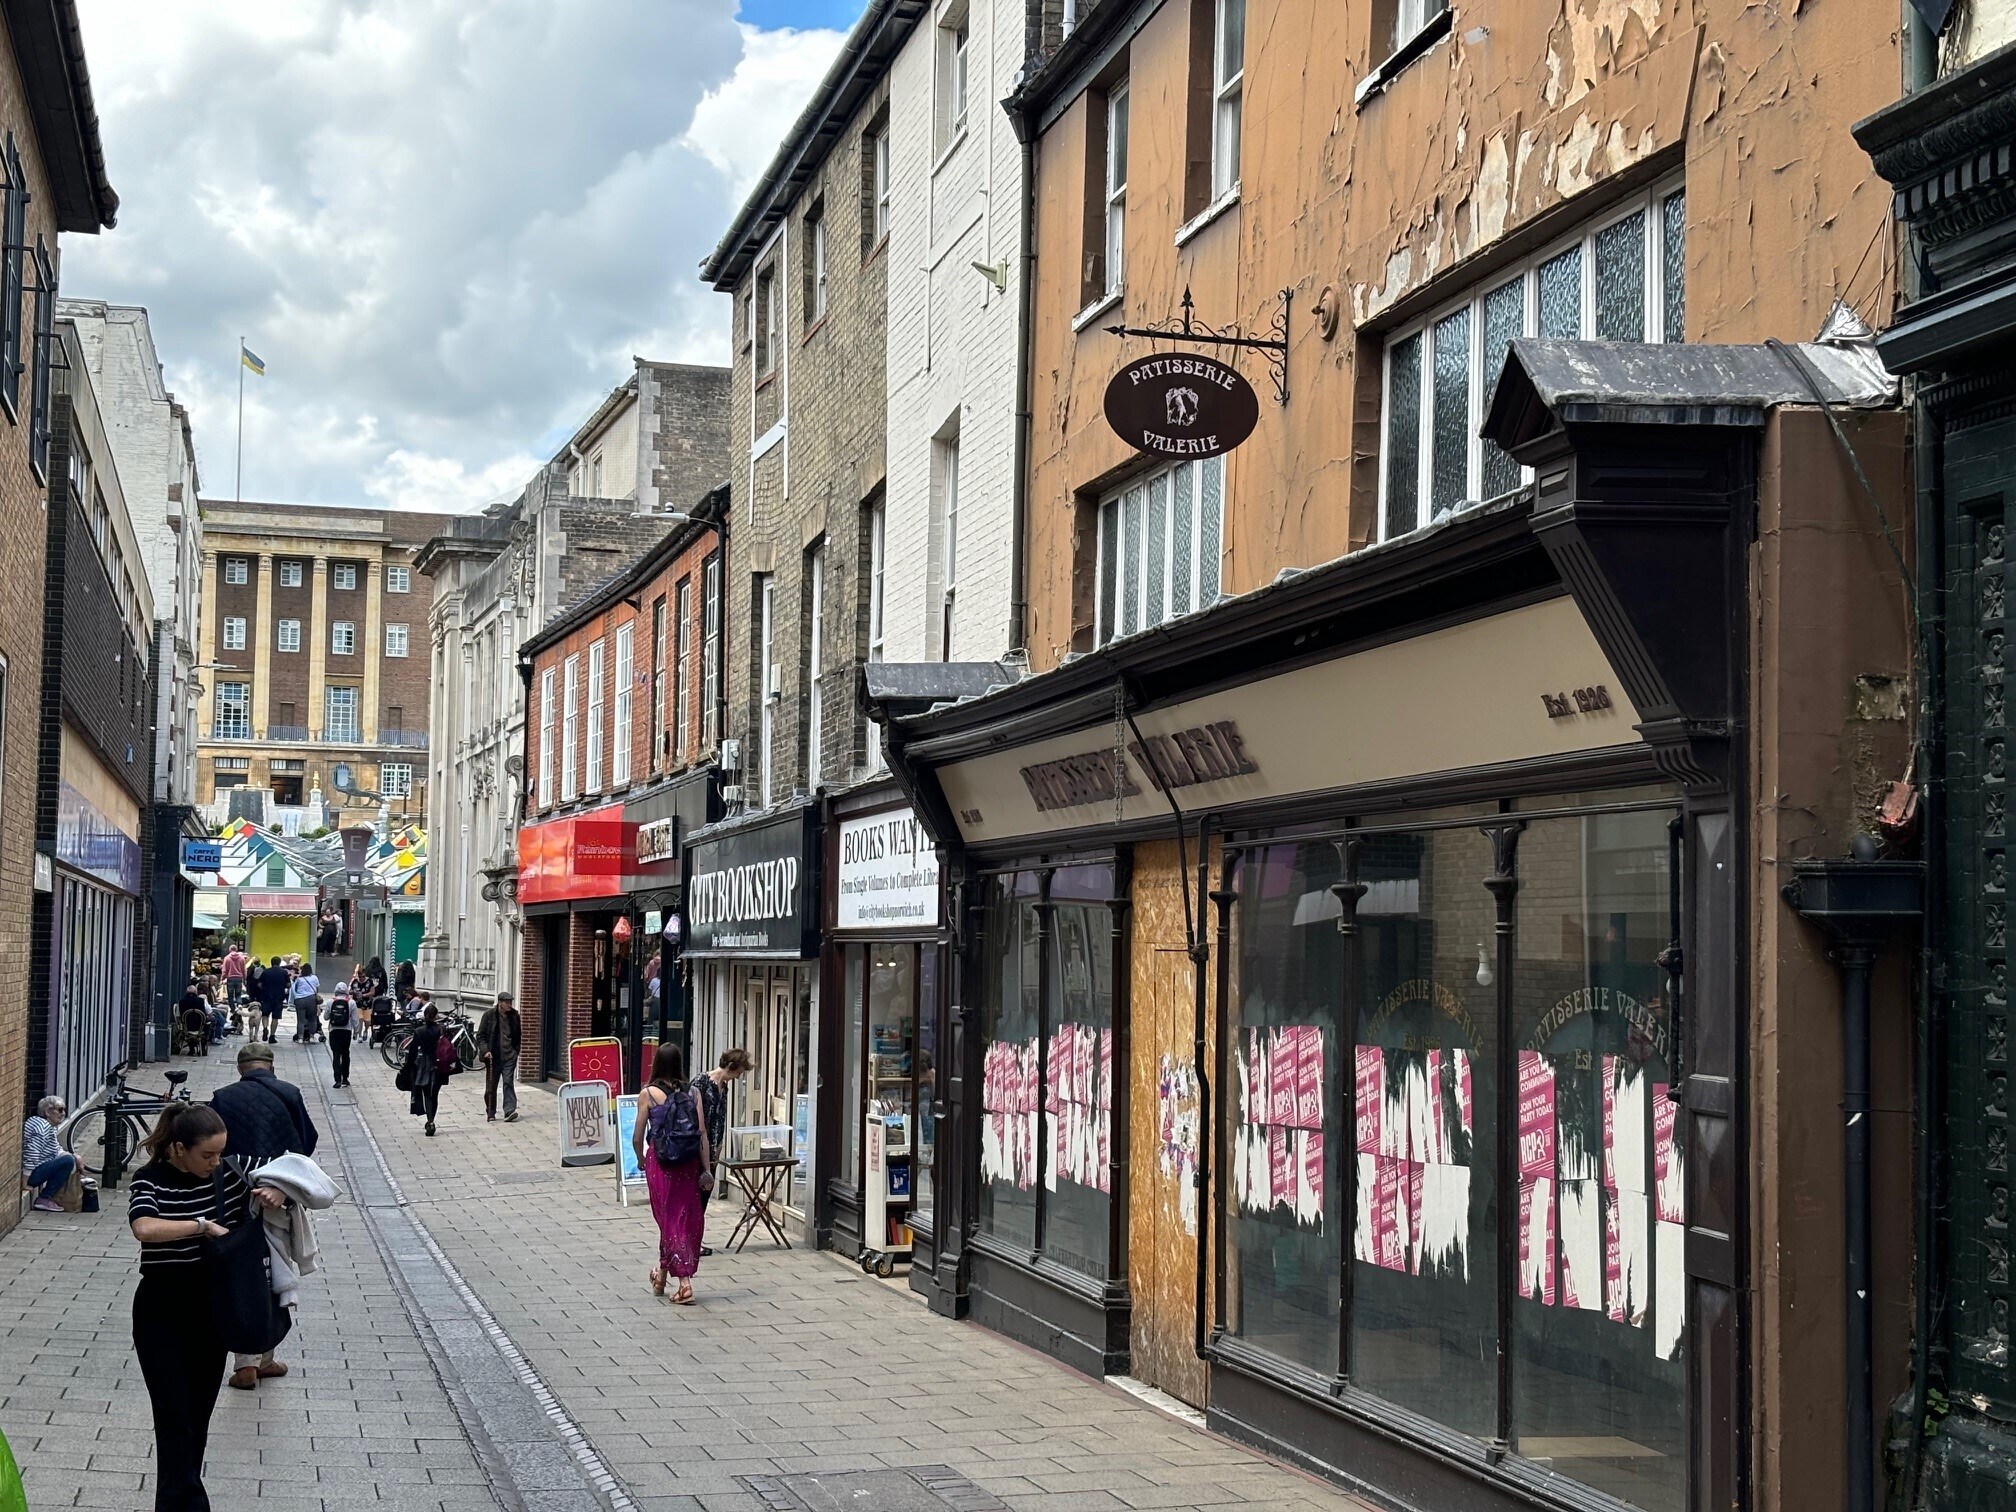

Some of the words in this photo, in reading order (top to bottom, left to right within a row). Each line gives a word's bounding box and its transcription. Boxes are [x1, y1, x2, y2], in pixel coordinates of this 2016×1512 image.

[1128, 359, 1237, 391] PATISSERIE
[1143, 430, 1220, 454] VALERIE
[1572, 686, 1610, 713] 1926
[350, 835, 362, 851] E
[844, 824, 884, 864] BOOKS
[188, 854, 220, 862] NERO
[689, 872, 716, 926] CITY
[717, 857, 797, 922] BOOKSHOP
[841, 879, 853, 894] From
[853, 876, 868, 896] Single
[890, 874, 896, 889] to
[896, 870, 922, 891] Complete
[1366, 979, 1430, 1043] PATISSERIE
[1526, 986, 1609, 1052] PATISSERIE
[1520, 1069, 1529, 1081] ARE
[1529, 1064, 1540, 1076] YOU
[566, 1095, 603, 1120] NATURAL
[1520, 1099, 1532, 1114] JOIN
[1532, 1094, 1546, 1108] YOUR
[1655, 1103, 1667, 1119] ARE
[572, 1118, 601, 1140] EAST
[1520, 1109, 1536, 1125] PARTY
[1520, 1132, 1537, 1165] RCP
[1520, 1192, 1530, 1204] ARE
[1381, 1230, 1395, 1259] RCP
